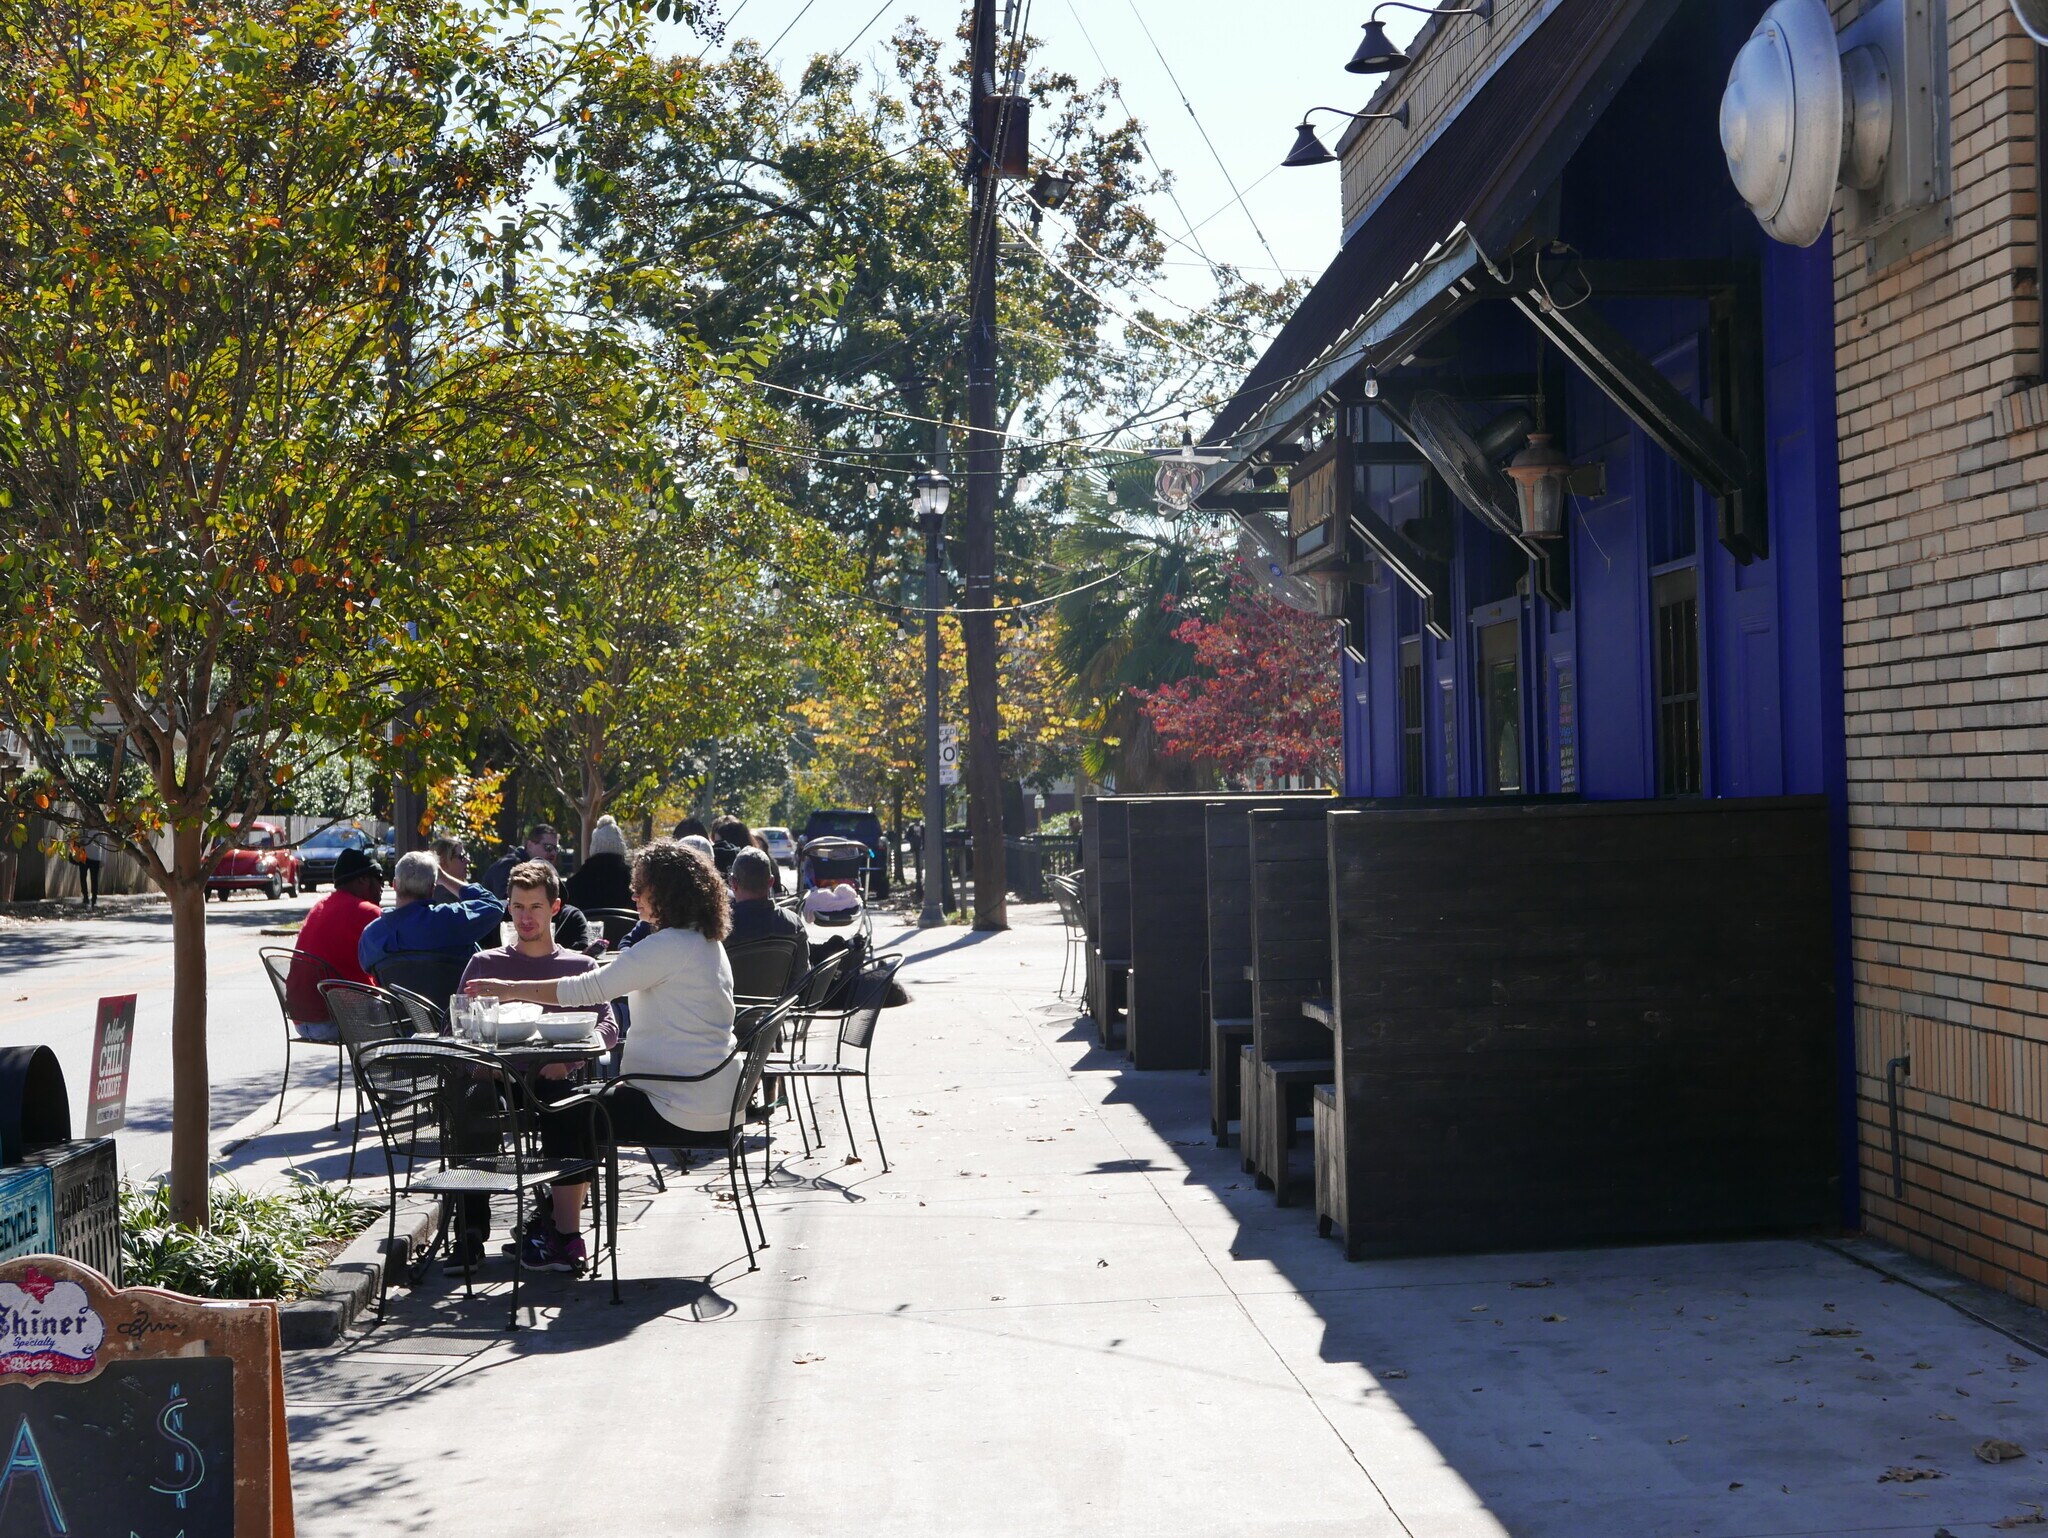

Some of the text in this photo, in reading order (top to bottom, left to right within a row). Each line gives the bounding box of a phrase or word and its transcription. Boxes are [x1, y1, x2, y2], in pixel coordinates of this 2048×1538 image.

[943, 747, 955, 761] 0
[99, 1043, 125, 1077] CHILI
[13, 1336, 56, 1350] Specialty
[11, 1357, 53, 1371] Beers
